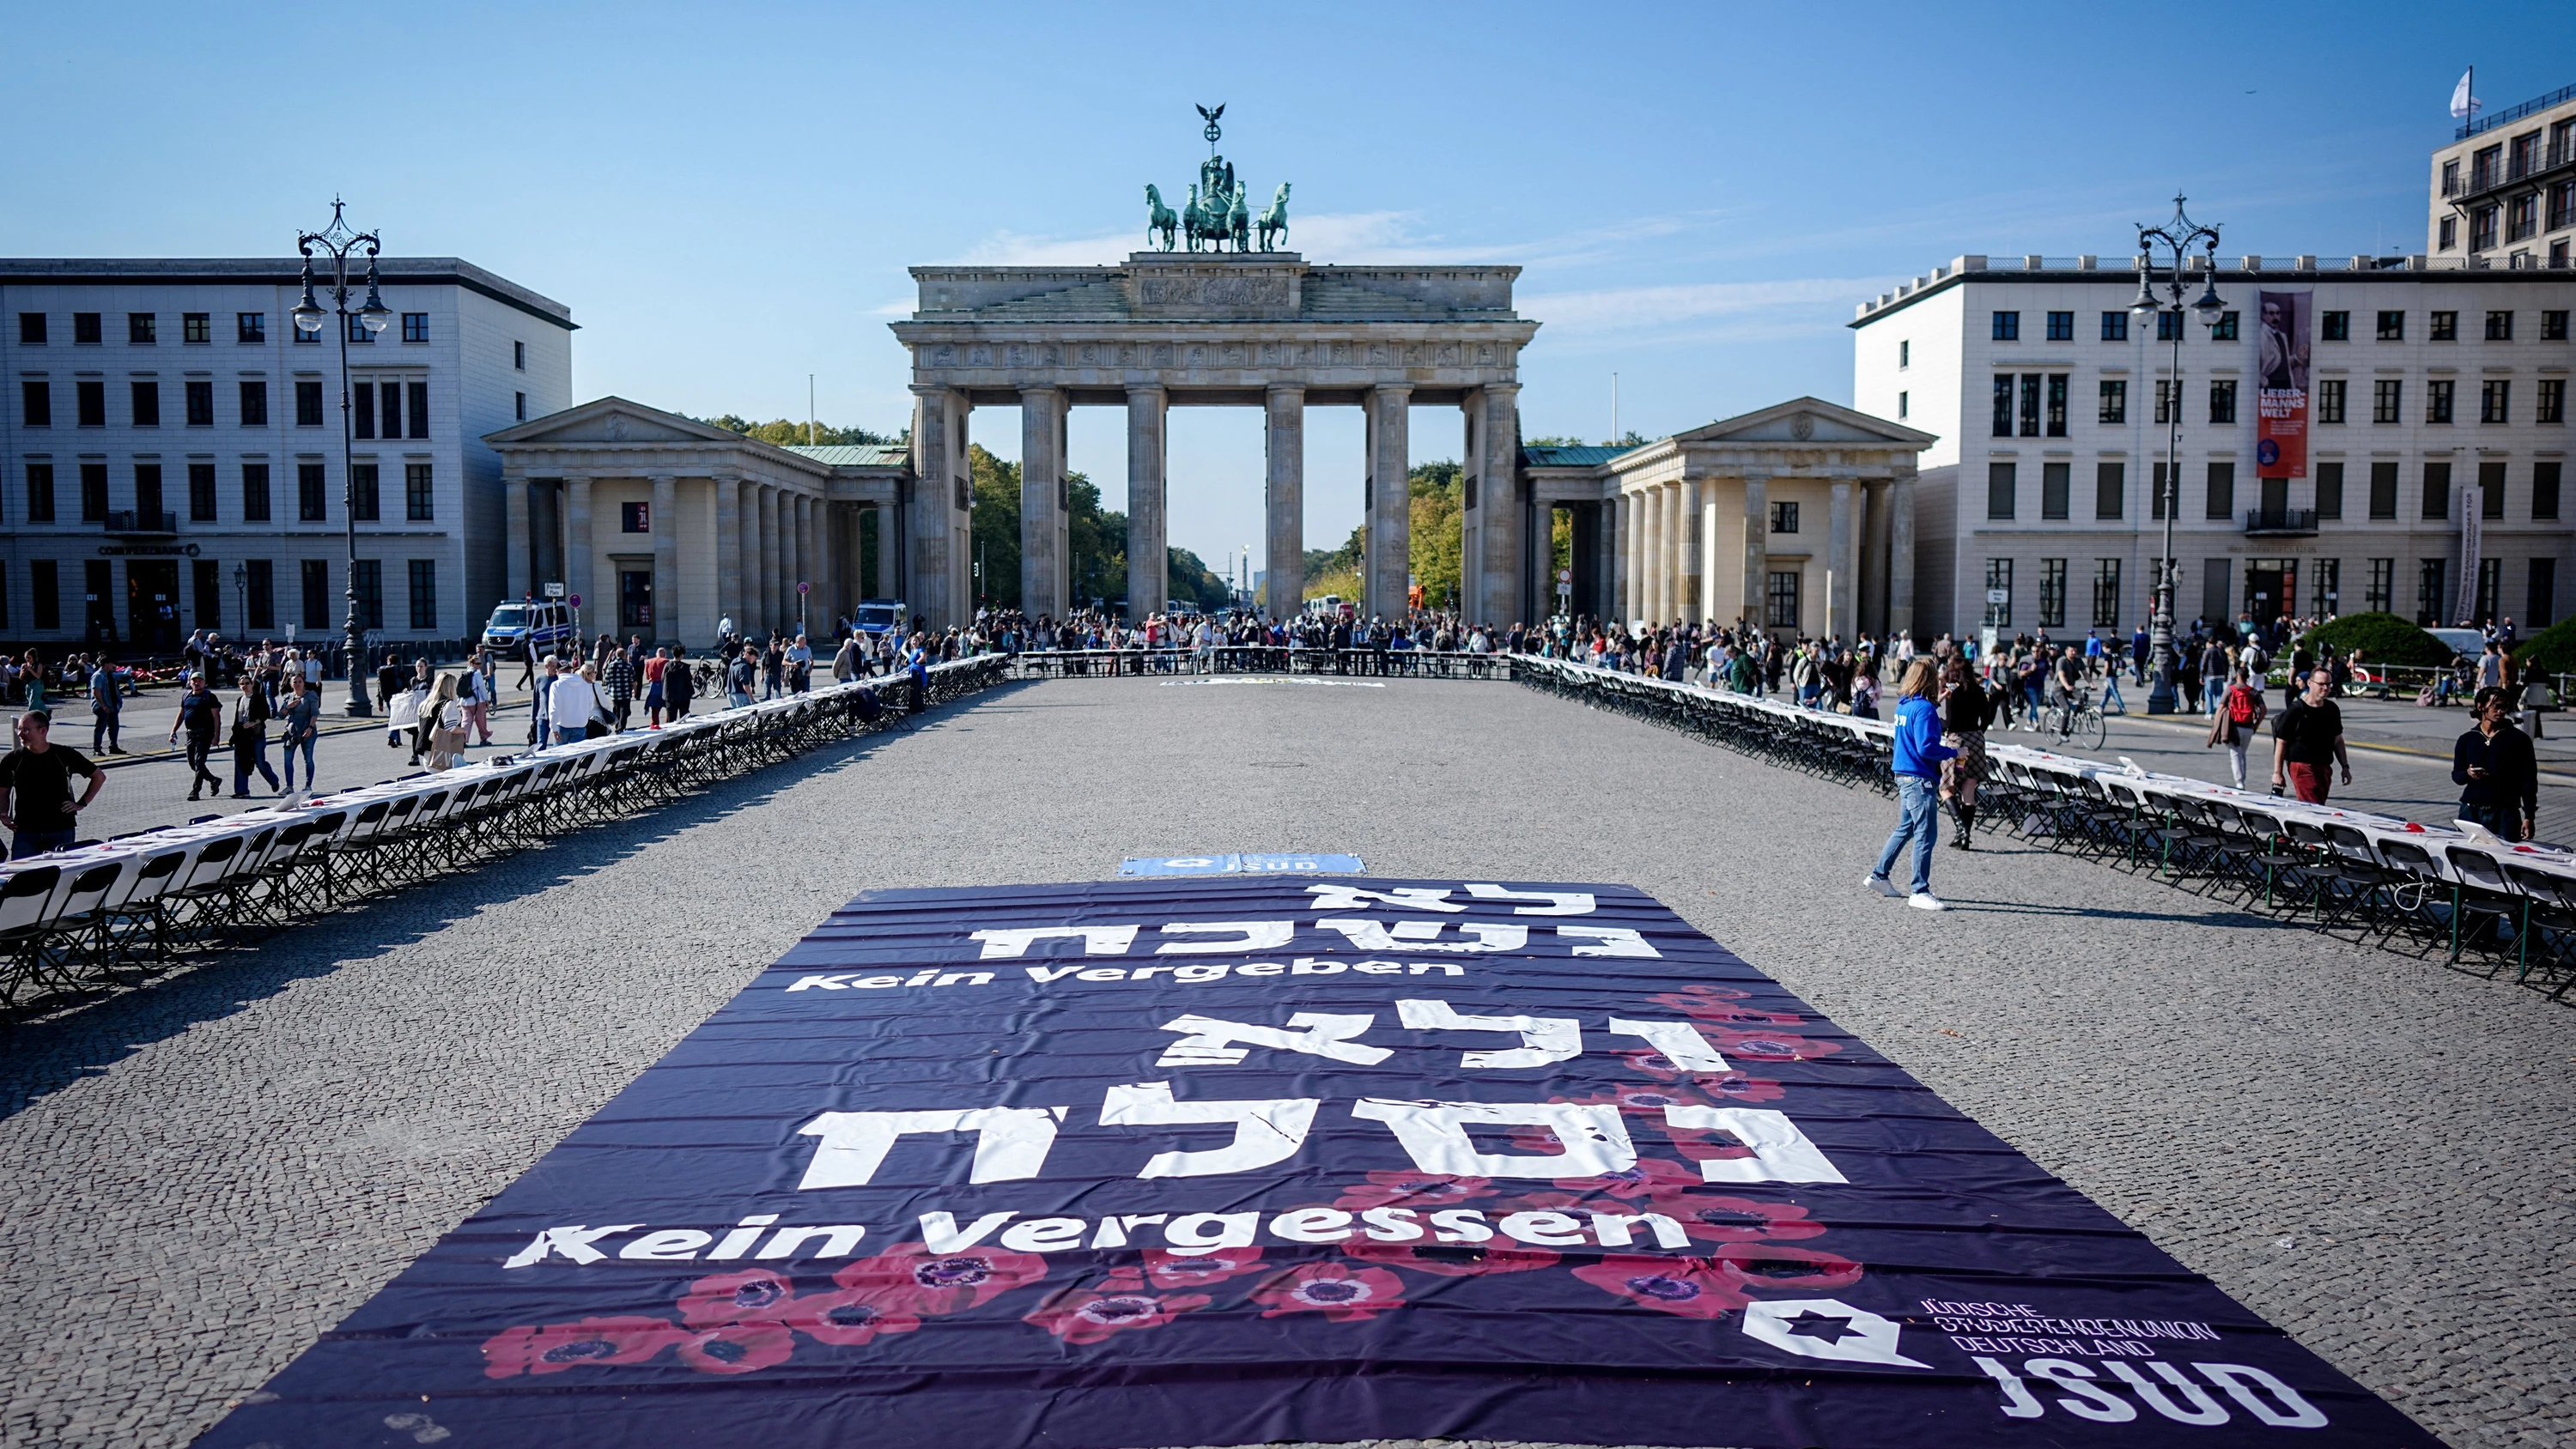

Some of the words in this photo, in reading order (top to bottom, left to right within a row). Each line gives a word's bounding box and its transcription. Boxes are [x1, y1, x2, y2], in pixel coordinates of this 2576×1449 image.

[2260, 388, 2306, 397] LIEBER-
[2260, 398, 2306, 408] MANNS
[2260, 408, 2292, 418] WELT
[1220, 862, 1318, 872] JSUD
[1304, 884, 1596, 916] לא
[967, 919, 1664, 961] נשכח
[785, 969, 996, 993] Kein
[1024, 957, 1465, 988] Vergeben
[1155, 999, 1733, 1072] ולא
[796, 1081, 1851, 1191] נסלח
[502, 1214, 866, 1270] Kein
[918, 1209, 1692, 1257] Vergessen
[1921, 1298, 2045, 1319] JÜDISCHE
[1933, 1317, 2221, 1341] STUDIERENDENUNION
[1950, 1336, 2155, 1356] DEUTSCHLAND
[1971, 1356, 2329, 1428] JSUD
